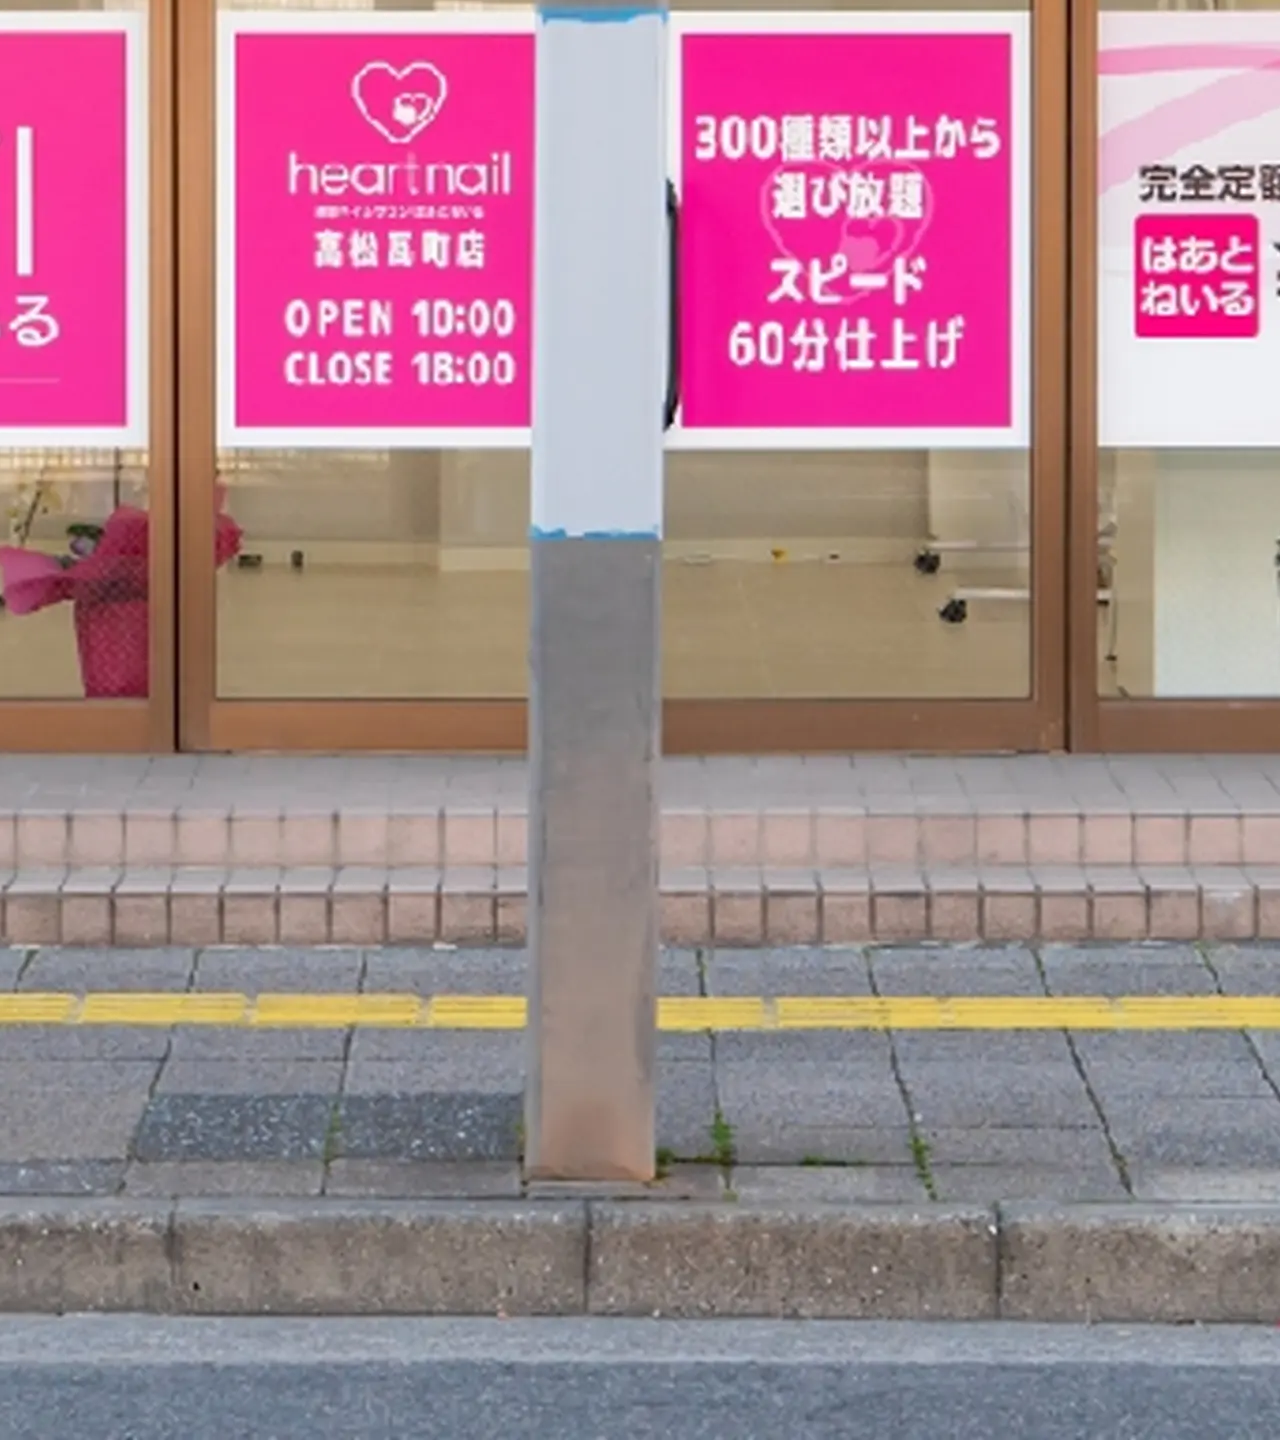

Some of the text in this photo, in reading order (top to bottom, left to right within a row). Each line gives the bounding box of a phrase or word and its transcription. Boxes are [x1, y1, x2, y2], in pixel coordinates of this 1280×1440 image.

[695, 114, 1001, 162] 300種類以上から
[772, 171, 924, 219] 選び放題
[1142, 236, 1254, 273] はあと
[767, 253, 927, 305] スピード
[1141, 281, 1255, 317] ねいる
[284, 299, 516, 337] OPEN 10:00
[729, 315, 965, 371] 60分仕上げ
[284, 351, 516, 385] CLOSE 18:00
